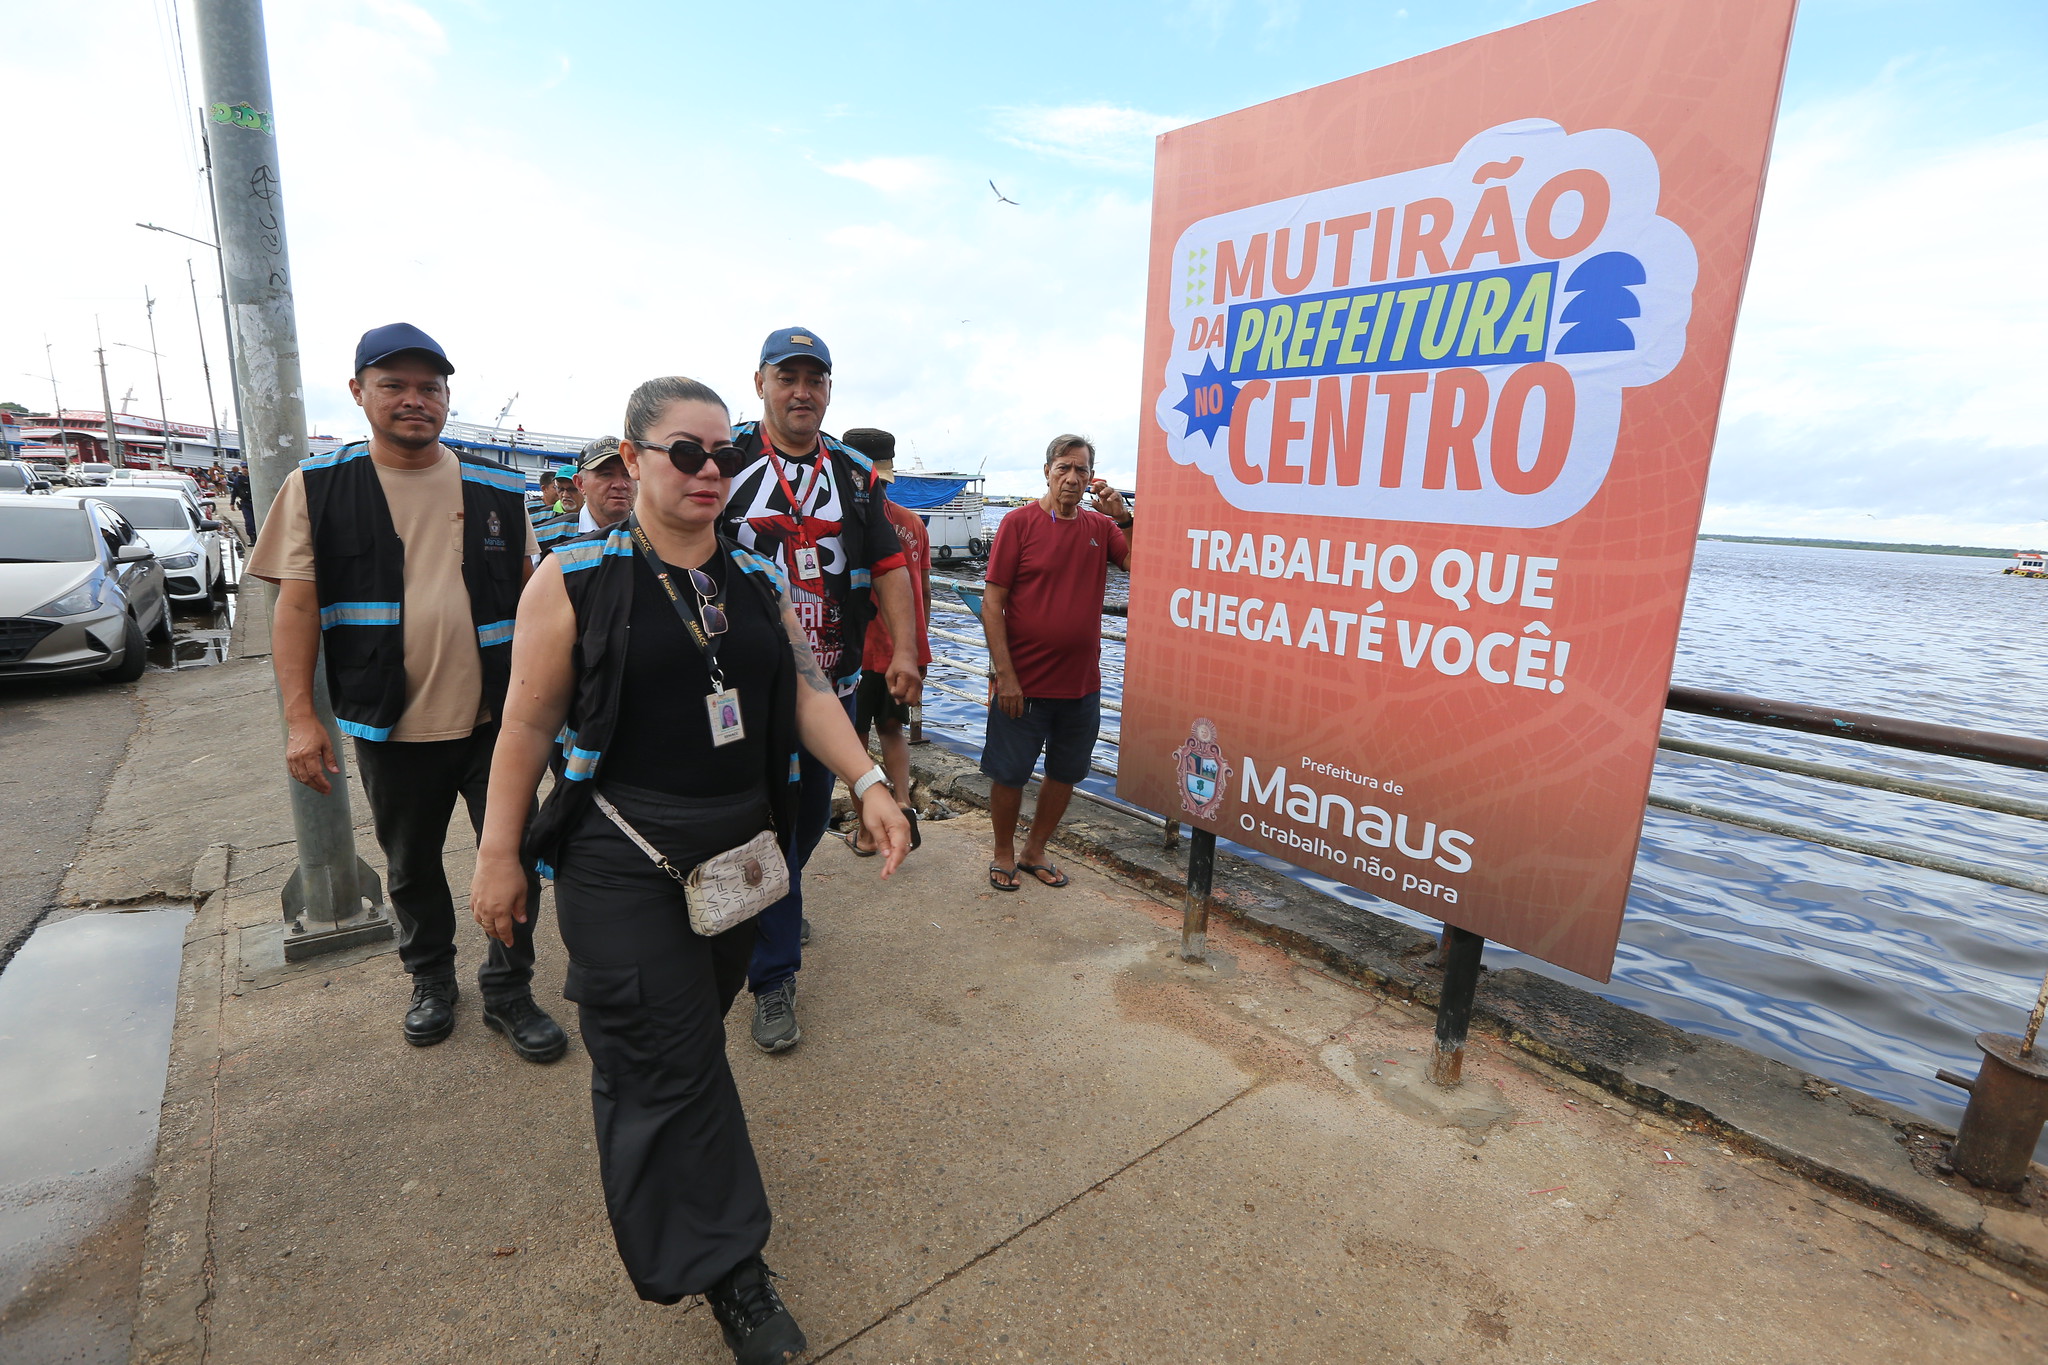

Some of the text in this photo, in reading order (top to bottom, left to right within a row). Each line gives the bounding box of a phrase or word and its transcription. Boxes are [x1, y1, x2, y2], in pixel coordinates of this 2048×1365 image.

[1212, 156, 1611, 305] MUTIRÃO
[1187, 271, 1553, 374] DA PREFEITURA
[1194, 361, 1576, 495] NO CENTRO
[634, 526, 652, 552] SEMACC
[1187, 529, 1559, 611] TRABALHO QUE
[662, 579, 678, 601] Manaus
[689, 620, 709, 647] SEMACC
[1169, 588, 1571, 695] CHEGA ATÉ VOCÊ!
[1240, 756, 1475, 874] Manaus
[1301, 756, 1404, 797] Prefeitura de
[1239, 813, 1459, 905] O trabalho não para
